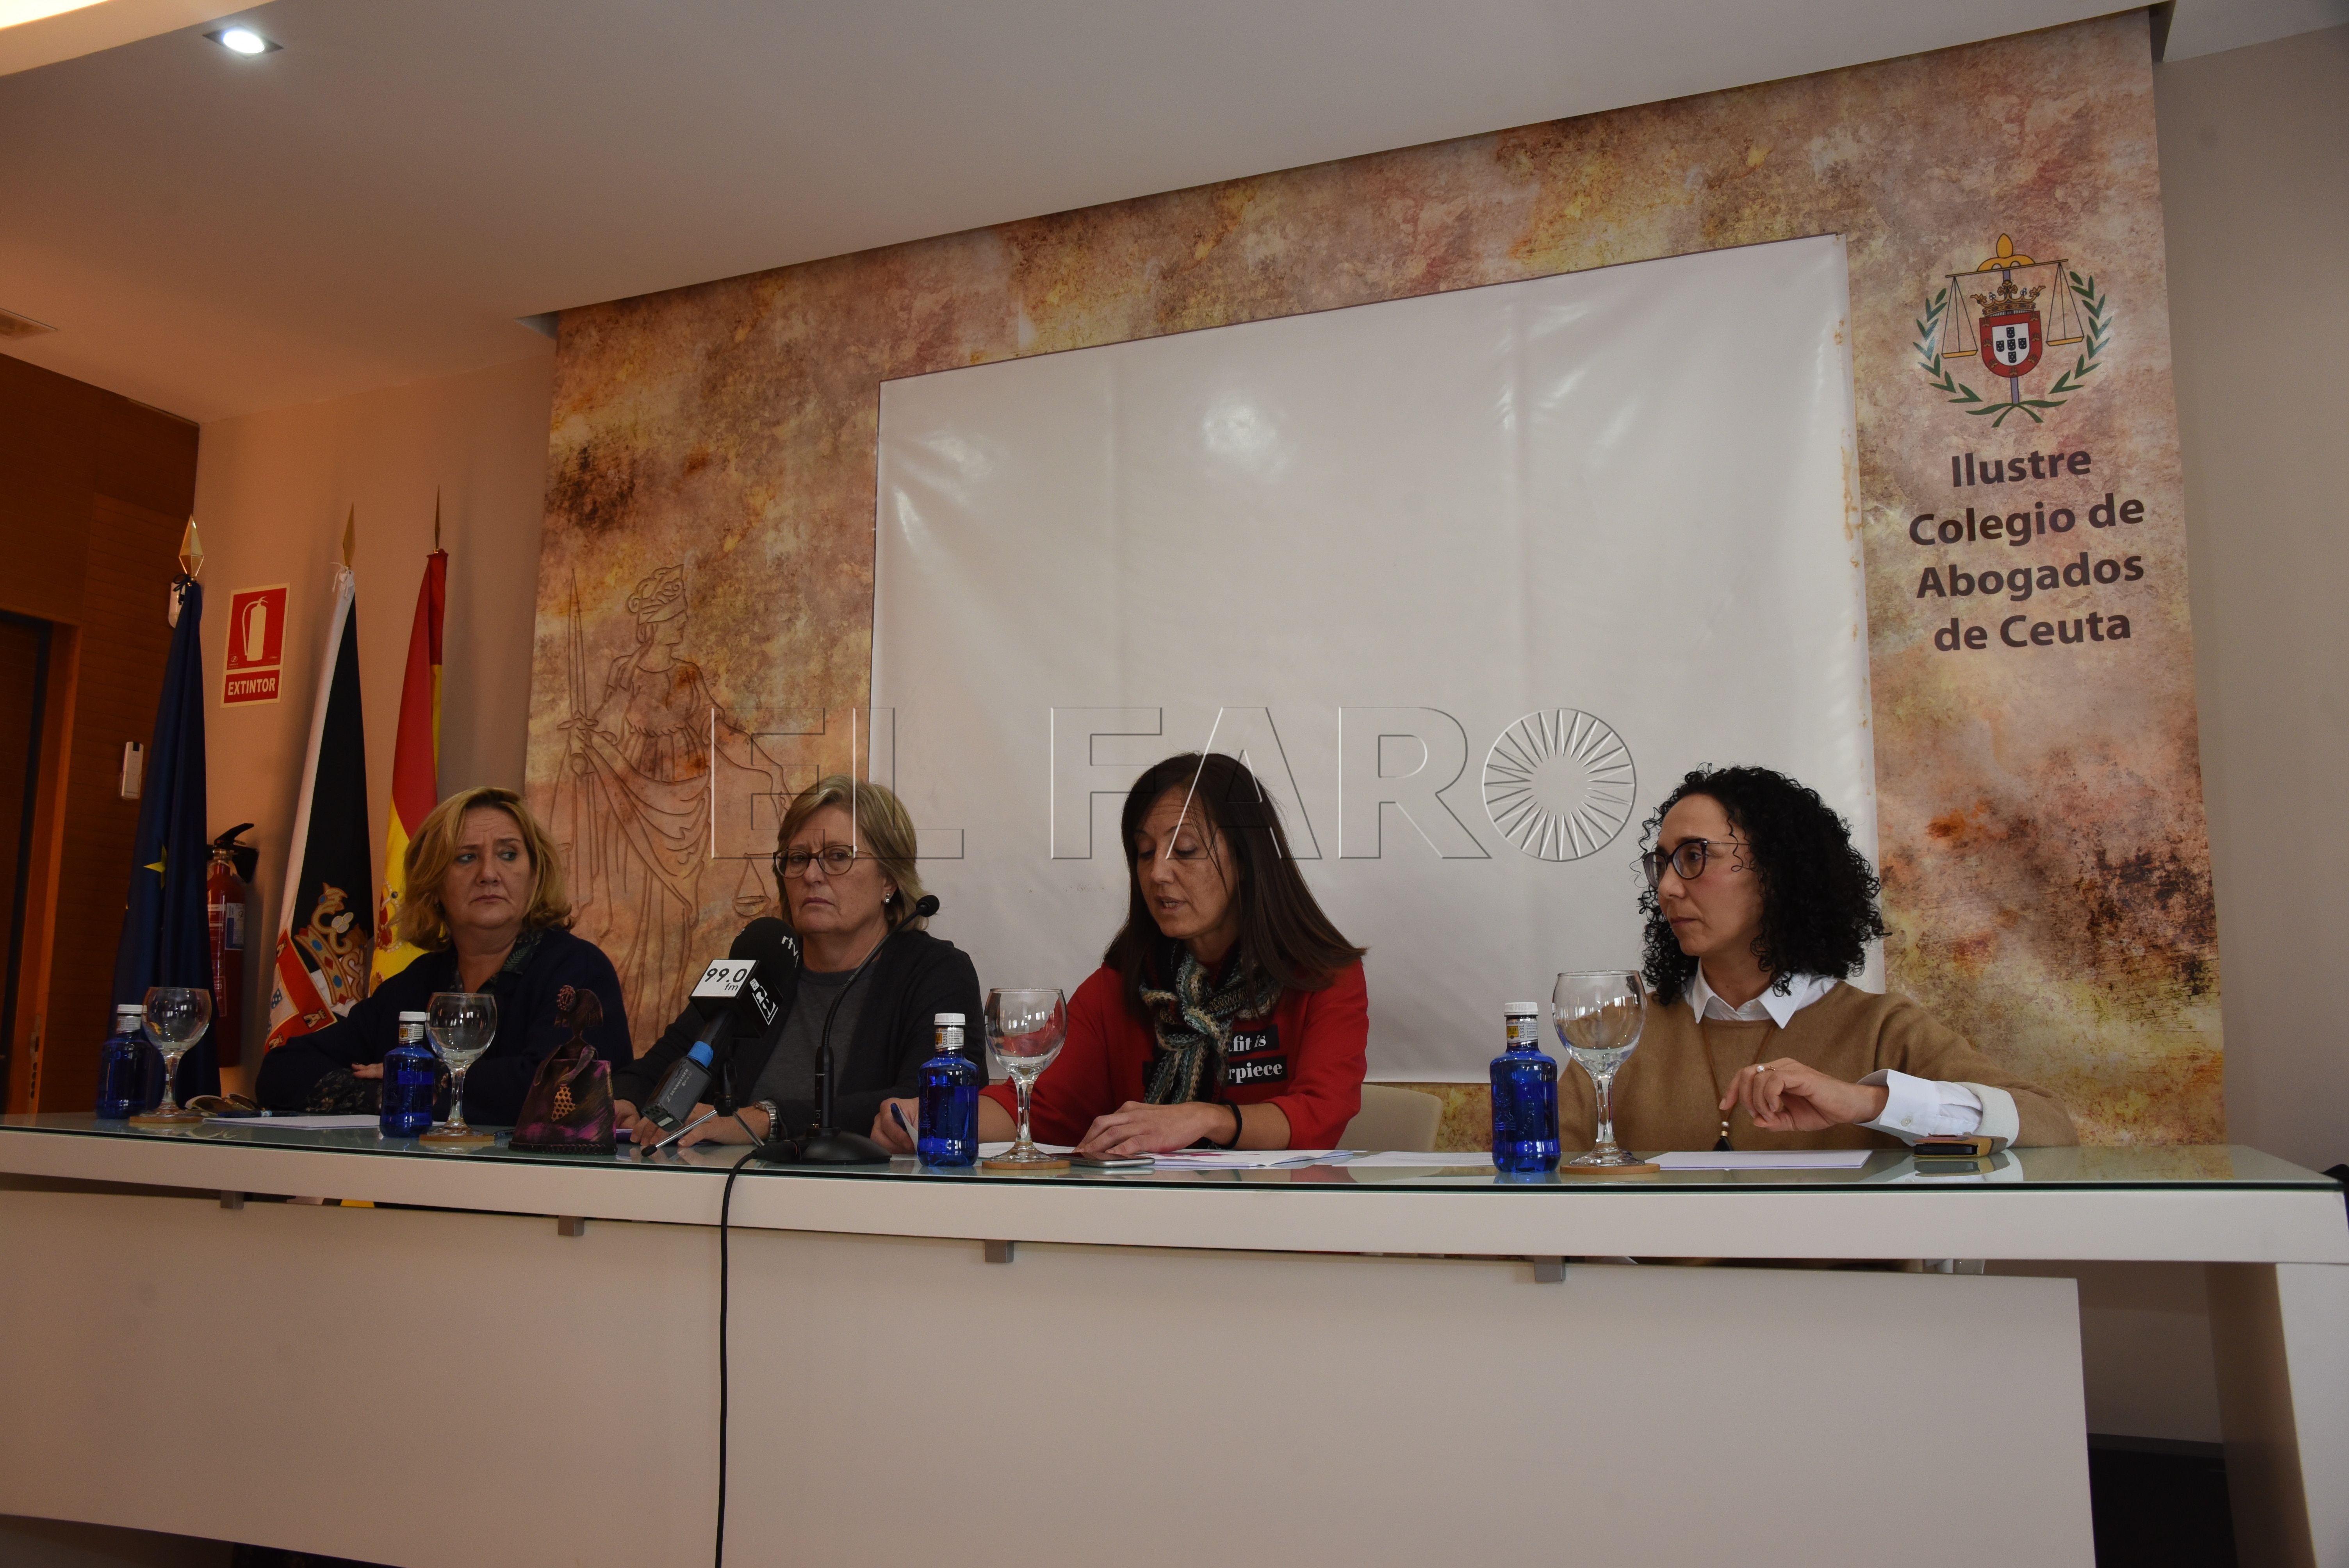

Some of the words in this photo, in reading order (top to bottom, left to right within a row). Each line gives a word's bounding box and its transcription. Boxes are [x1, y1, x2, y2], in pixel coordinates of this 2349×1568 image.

[1952, 450, 2091, 487] Ilustre
[1909, 501, 2076, 546] Colegio
[2088, 493, 2144, 529] de
[1916, 552, 2144, 601] Abogados
[1934, 618, 1987, 652] de
[2000, 611, 2131, 647] Ceuta
[228, 677, 276, 695] EXTINTOR
[781, 935, 799, 968] rtv
[704, 968, 748, 983] 99.0
[1254, 1035, 1266, 1048] is
[670, 1068, 689, 1096] SENNHEISER
